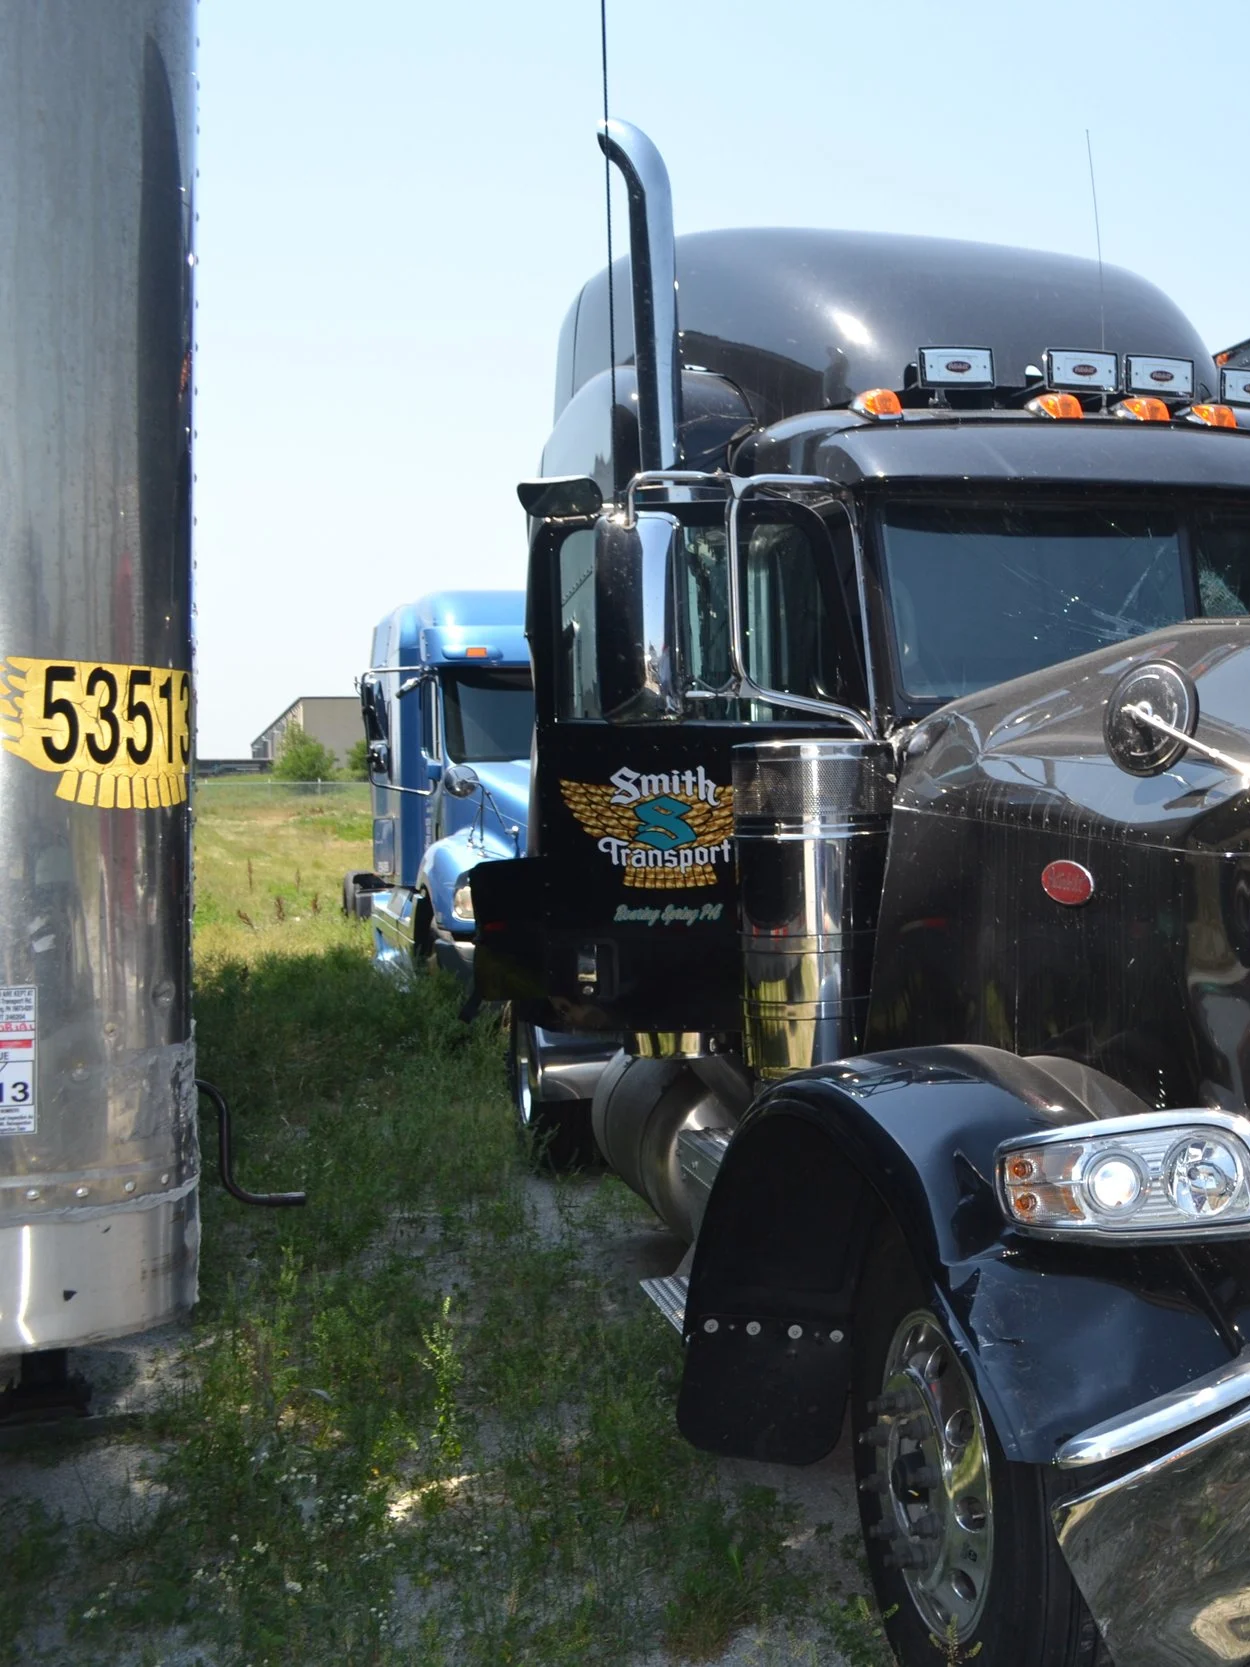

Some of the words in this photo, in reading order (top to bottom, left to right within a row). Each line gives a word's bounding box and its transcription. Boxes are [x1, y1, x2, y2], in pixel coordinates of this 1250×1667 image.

[41, 665, 191, 766] 53513
[609, 765, 721, 807] Smith
[633, 794, 699, 851] S
[597, 836, 732, 875] Transport
